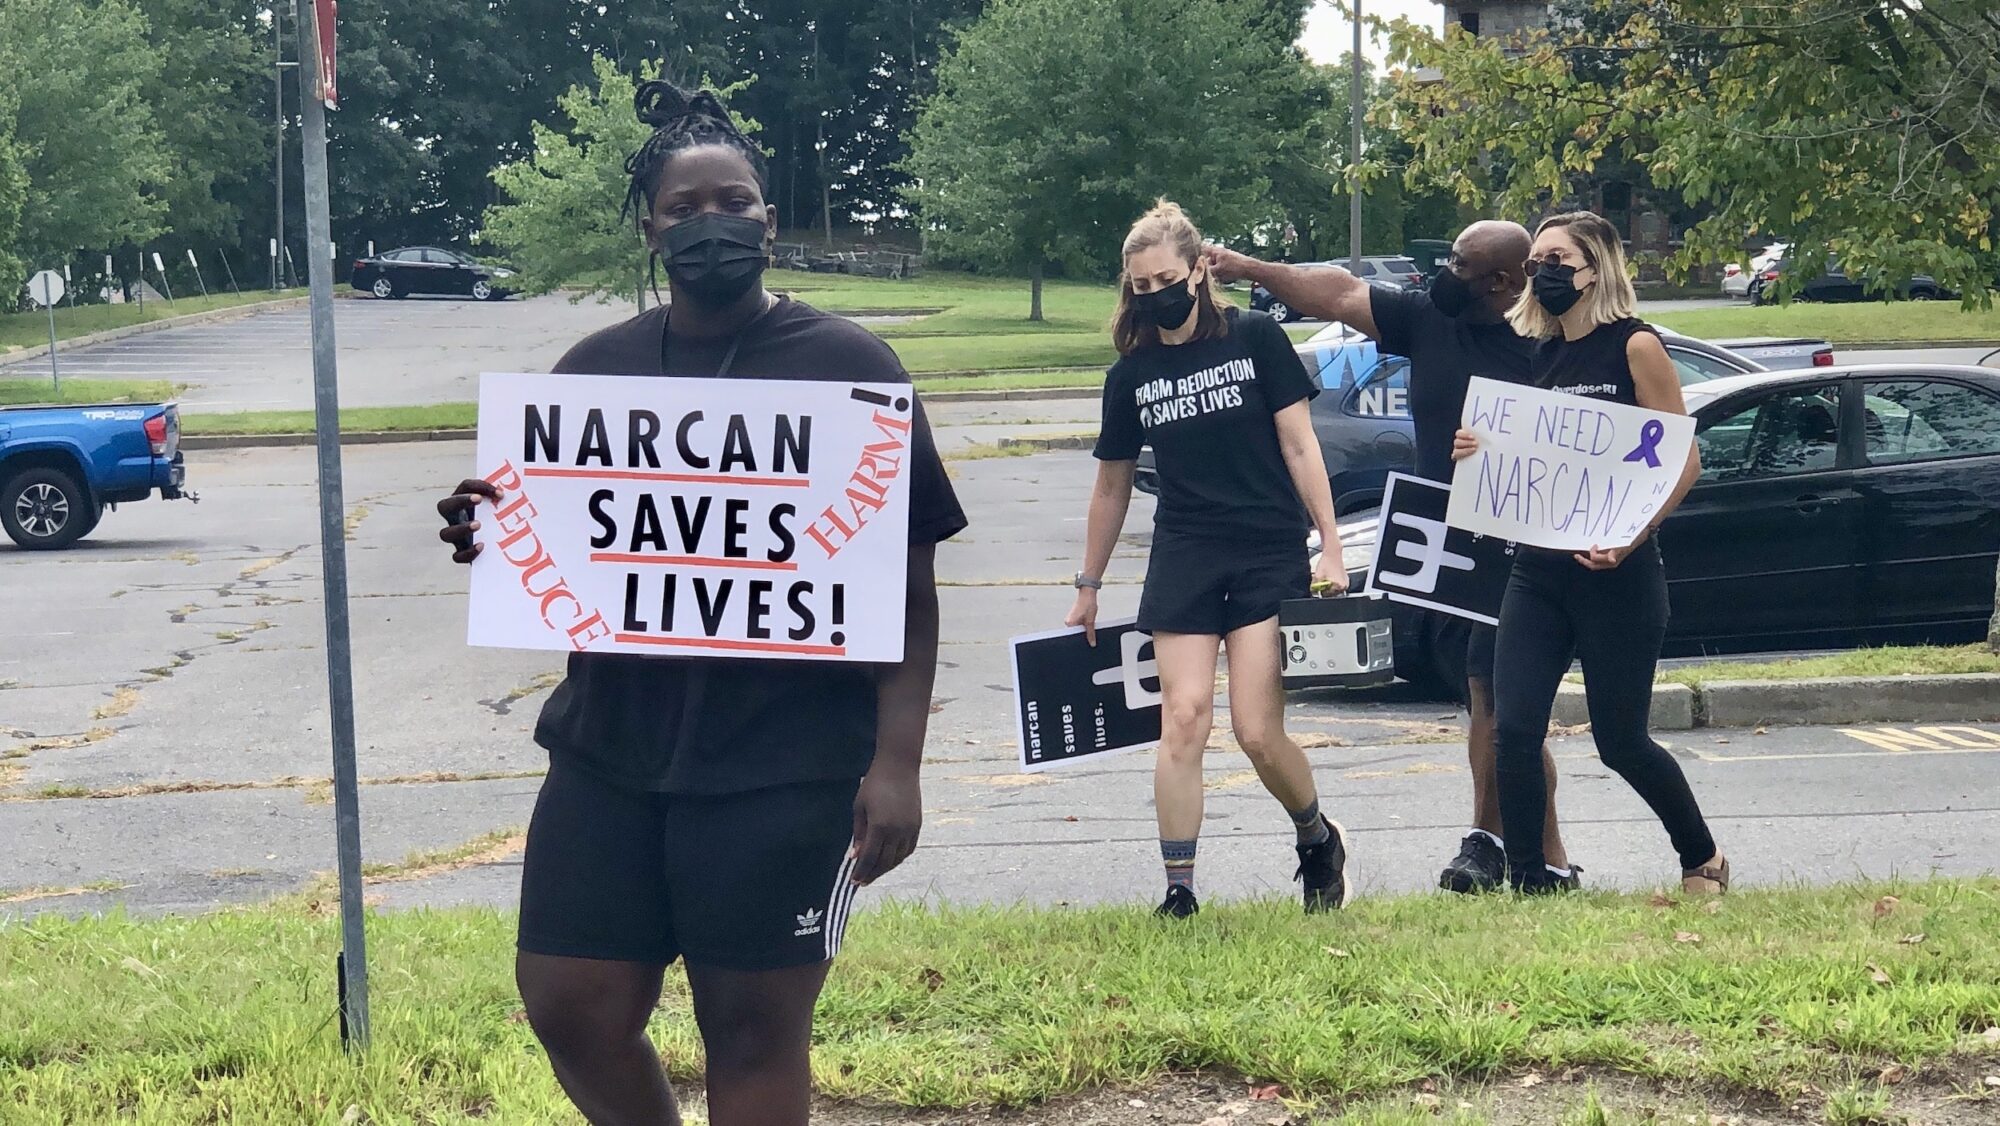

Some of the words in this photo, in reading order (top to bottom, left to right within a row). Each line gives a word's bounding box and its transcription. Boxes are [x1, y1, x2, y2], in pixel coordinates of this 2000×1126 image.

[1135, 377, 1173, 407] HARM
[1177, 357, 1256, 397] REDUCTION
[1153, 394, 1198, 426] SAVES
[1200, 384, 1243, 414] LIVES
[523, 404, 812, 474] NARCAN
[1471, 395, 1517, 434] WE
[1534, 405, 1615, 456] NEED
[588, 488, 797, 563] SAVES
[1474, 450, 1633, 537] NARCAN
[482, 458, 611, 652] REDUCE
[623, 573, 846, 646] LIVES!
[1026, 700, 1042, 759] narcan
[794, 926, 820, 936] adidas
